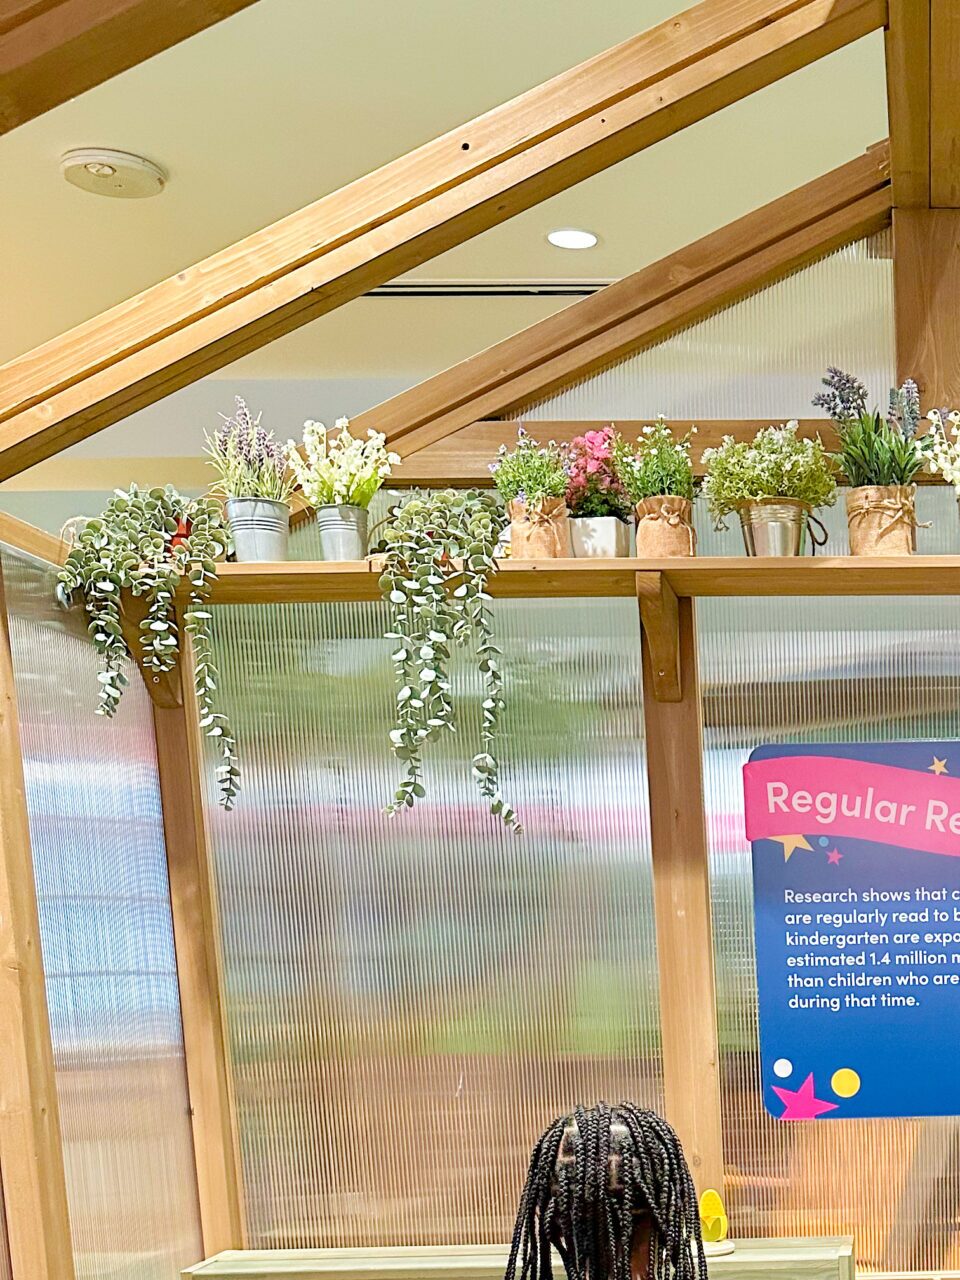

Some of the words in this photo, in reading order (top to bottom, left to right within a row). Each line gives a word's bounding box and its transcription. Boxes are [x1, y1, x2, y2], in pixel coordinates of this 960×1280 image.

[766, 781, 917, 826] Regular
[784, 888, 858, 904] Research
[862, 887, 911, 902] shows
[914, 887, 948, 901] that
[784, 914, 812, 925] are
[816, 908, 888, 928] regularly
[892, 907, 929, 923] read
[933, 909, 949, 922] to
[785, 931, 889, 949] kindergarten
[893, 932, 920, 945] are
[786, 951, 866, 967] estimated
[869, 952, 891, 966] 1.4
[895, 950, 947, 965] million
[787, 973, 824, 988] than
[828, 972, 892, 987] children
[896, 971, 929, 986] who
[788, 994, 841, 1012] during
[844, 993, 877, 1008] that
[880, 993, 920, 1007] time.
